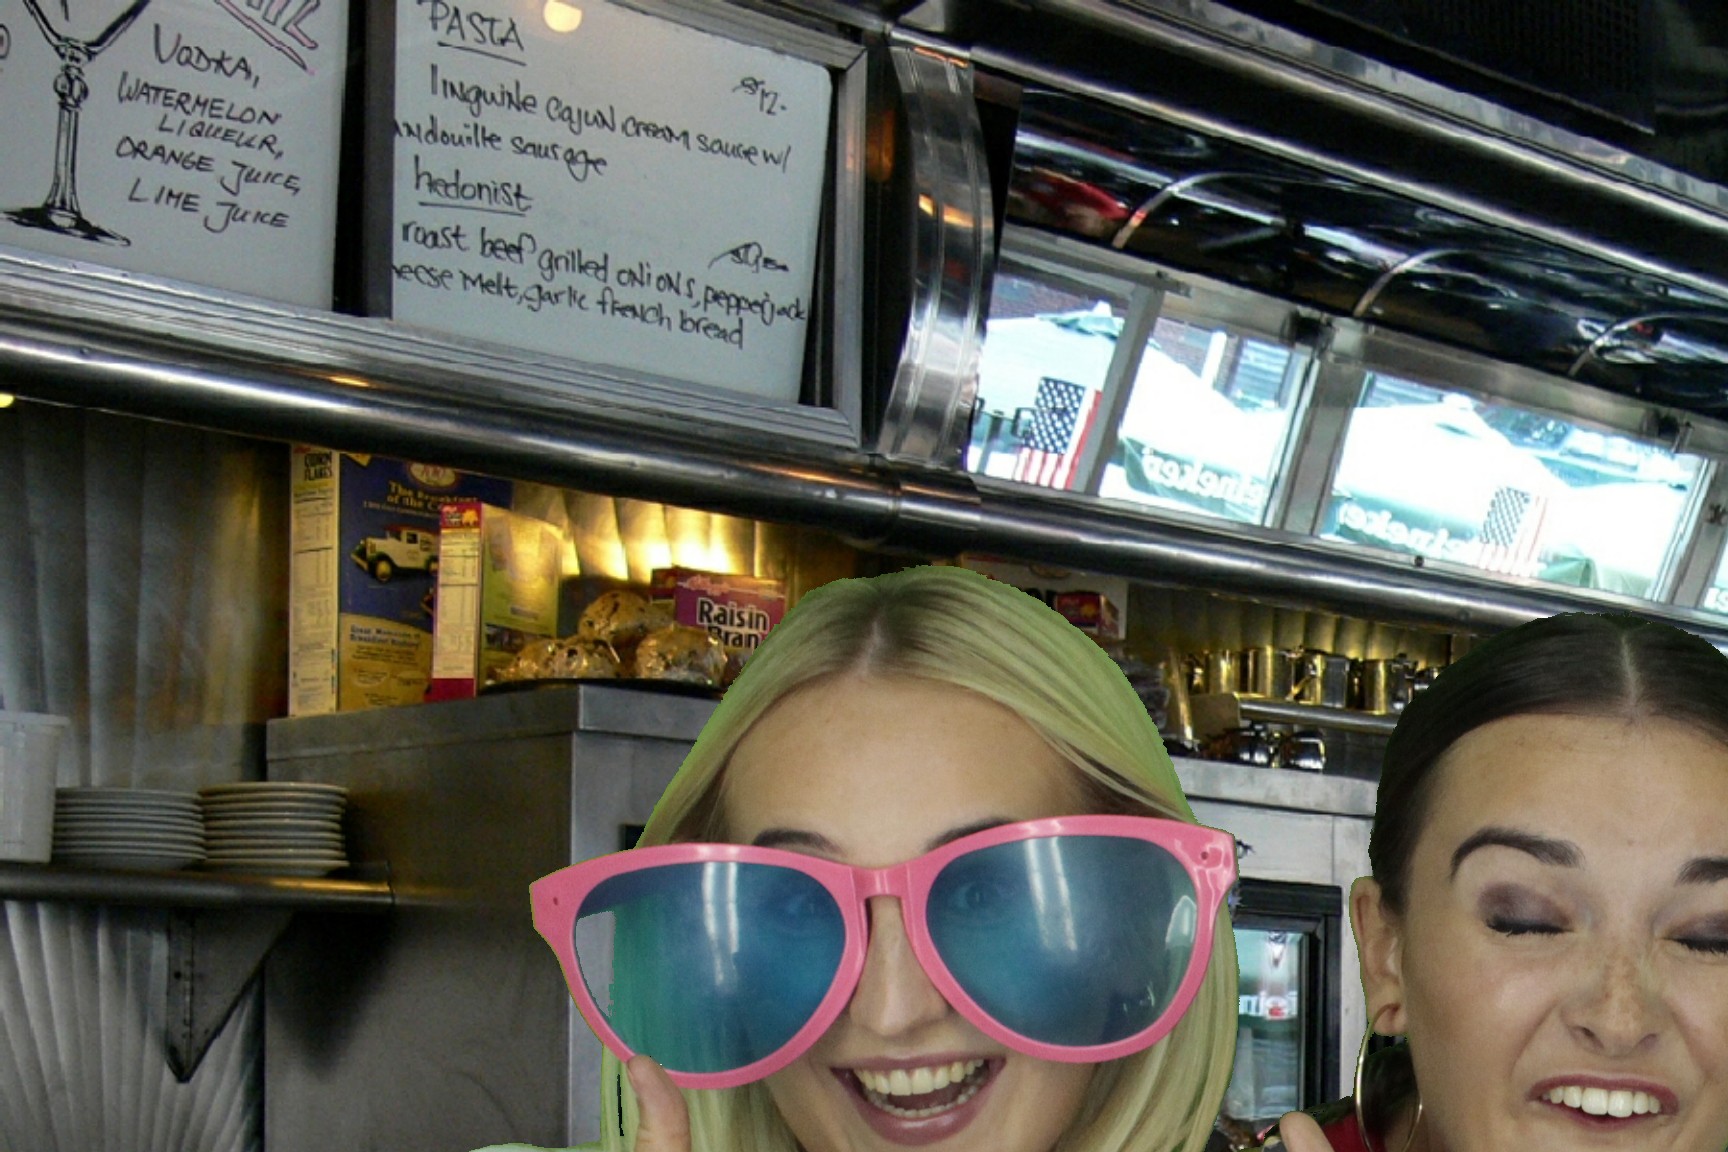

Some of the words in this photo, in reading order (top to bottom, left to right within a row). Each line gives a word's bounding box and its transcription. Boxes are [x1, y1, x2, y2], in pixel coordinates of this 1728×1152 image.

[417, 0, 525, 51] PASTA
[117, 71, 283, 126] WATERMELON
[115, 136, 215, 173] ORANGE
[128, 177, 201, 213] LIME
[203, 200, 290, 234] JUICE
[413, 153, 535, 212] hedonist
[402, 220, 471, 252] roast
[479, 226, 537, 265] beef
[538, 248, 610, 284] grilled
[697, 597, 770, 634] Raisin
